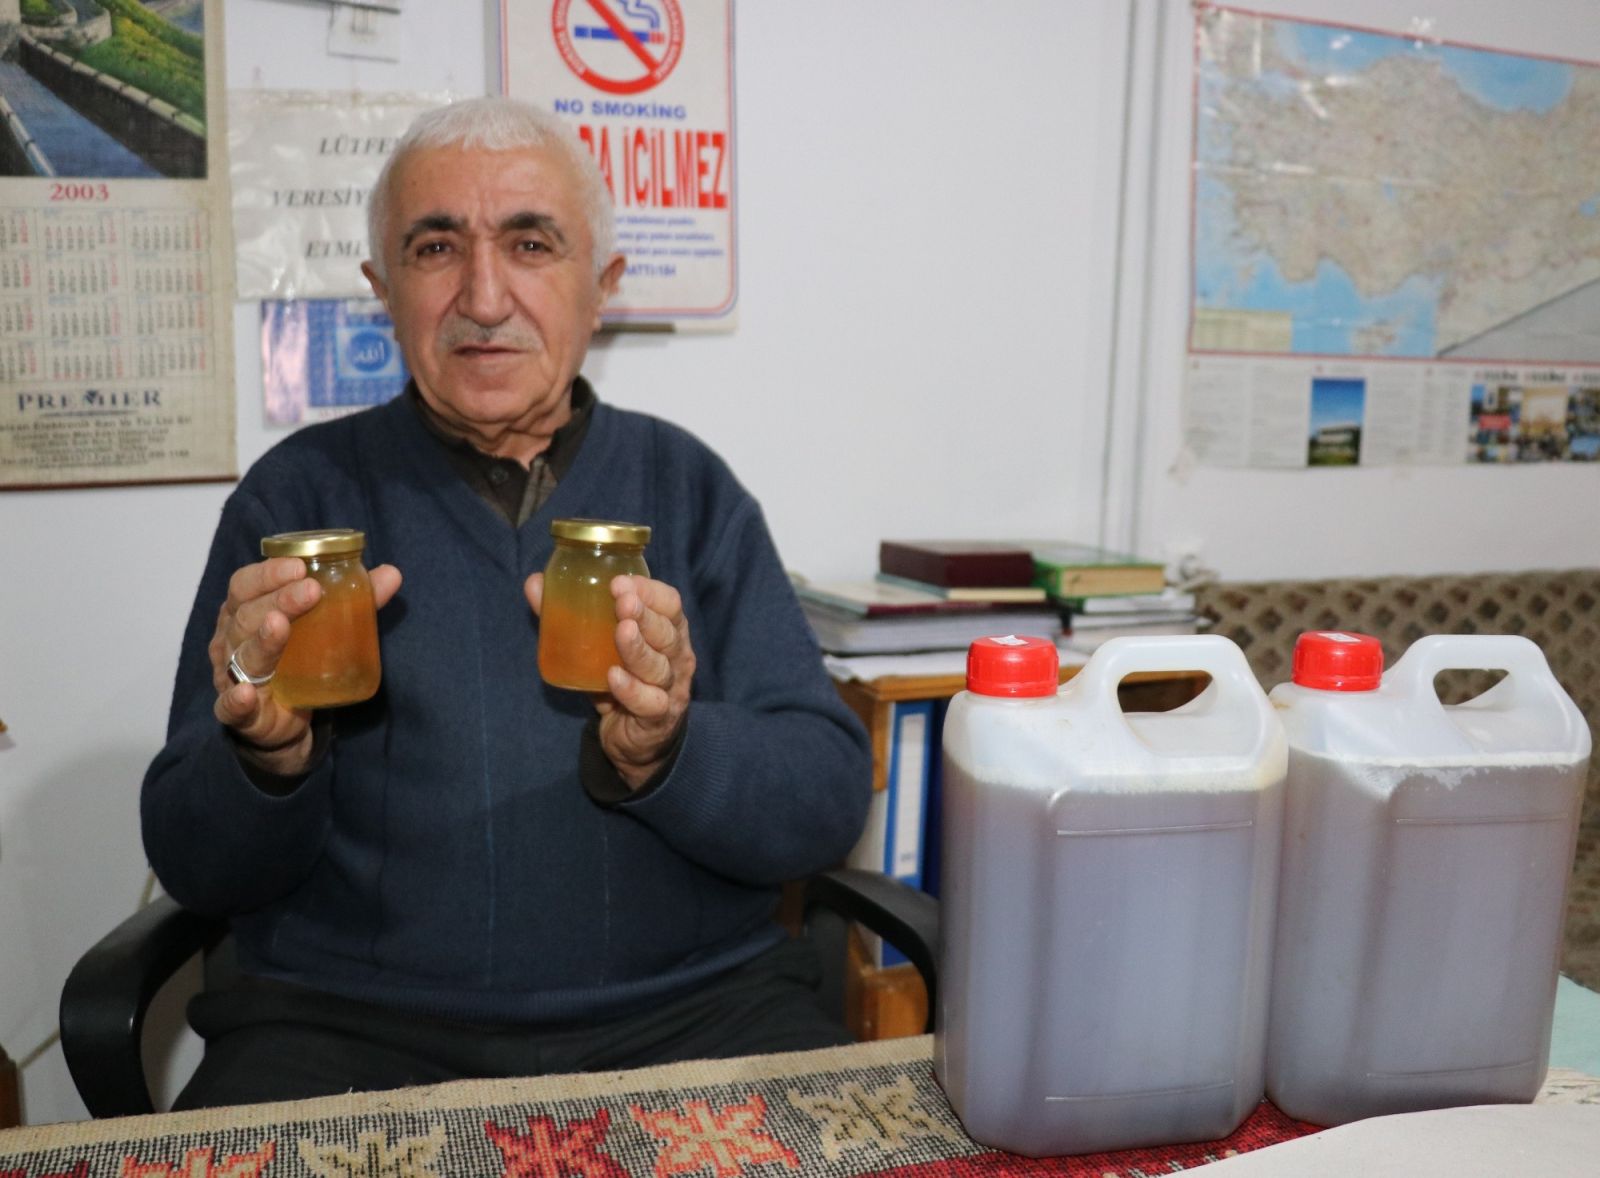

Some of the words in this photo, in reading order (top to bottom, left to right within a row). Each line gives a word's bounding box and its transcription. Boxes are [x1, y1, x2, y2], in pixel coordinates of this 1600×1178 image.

[554, 99, 584, 114] NO
[319, 133, 402, 154] LÜTFE
[622, 126, 728, 209] İÇİLMEZ
[50, 183, 109, 201] 2003
[19, 389, 161, 411] PREMIER
